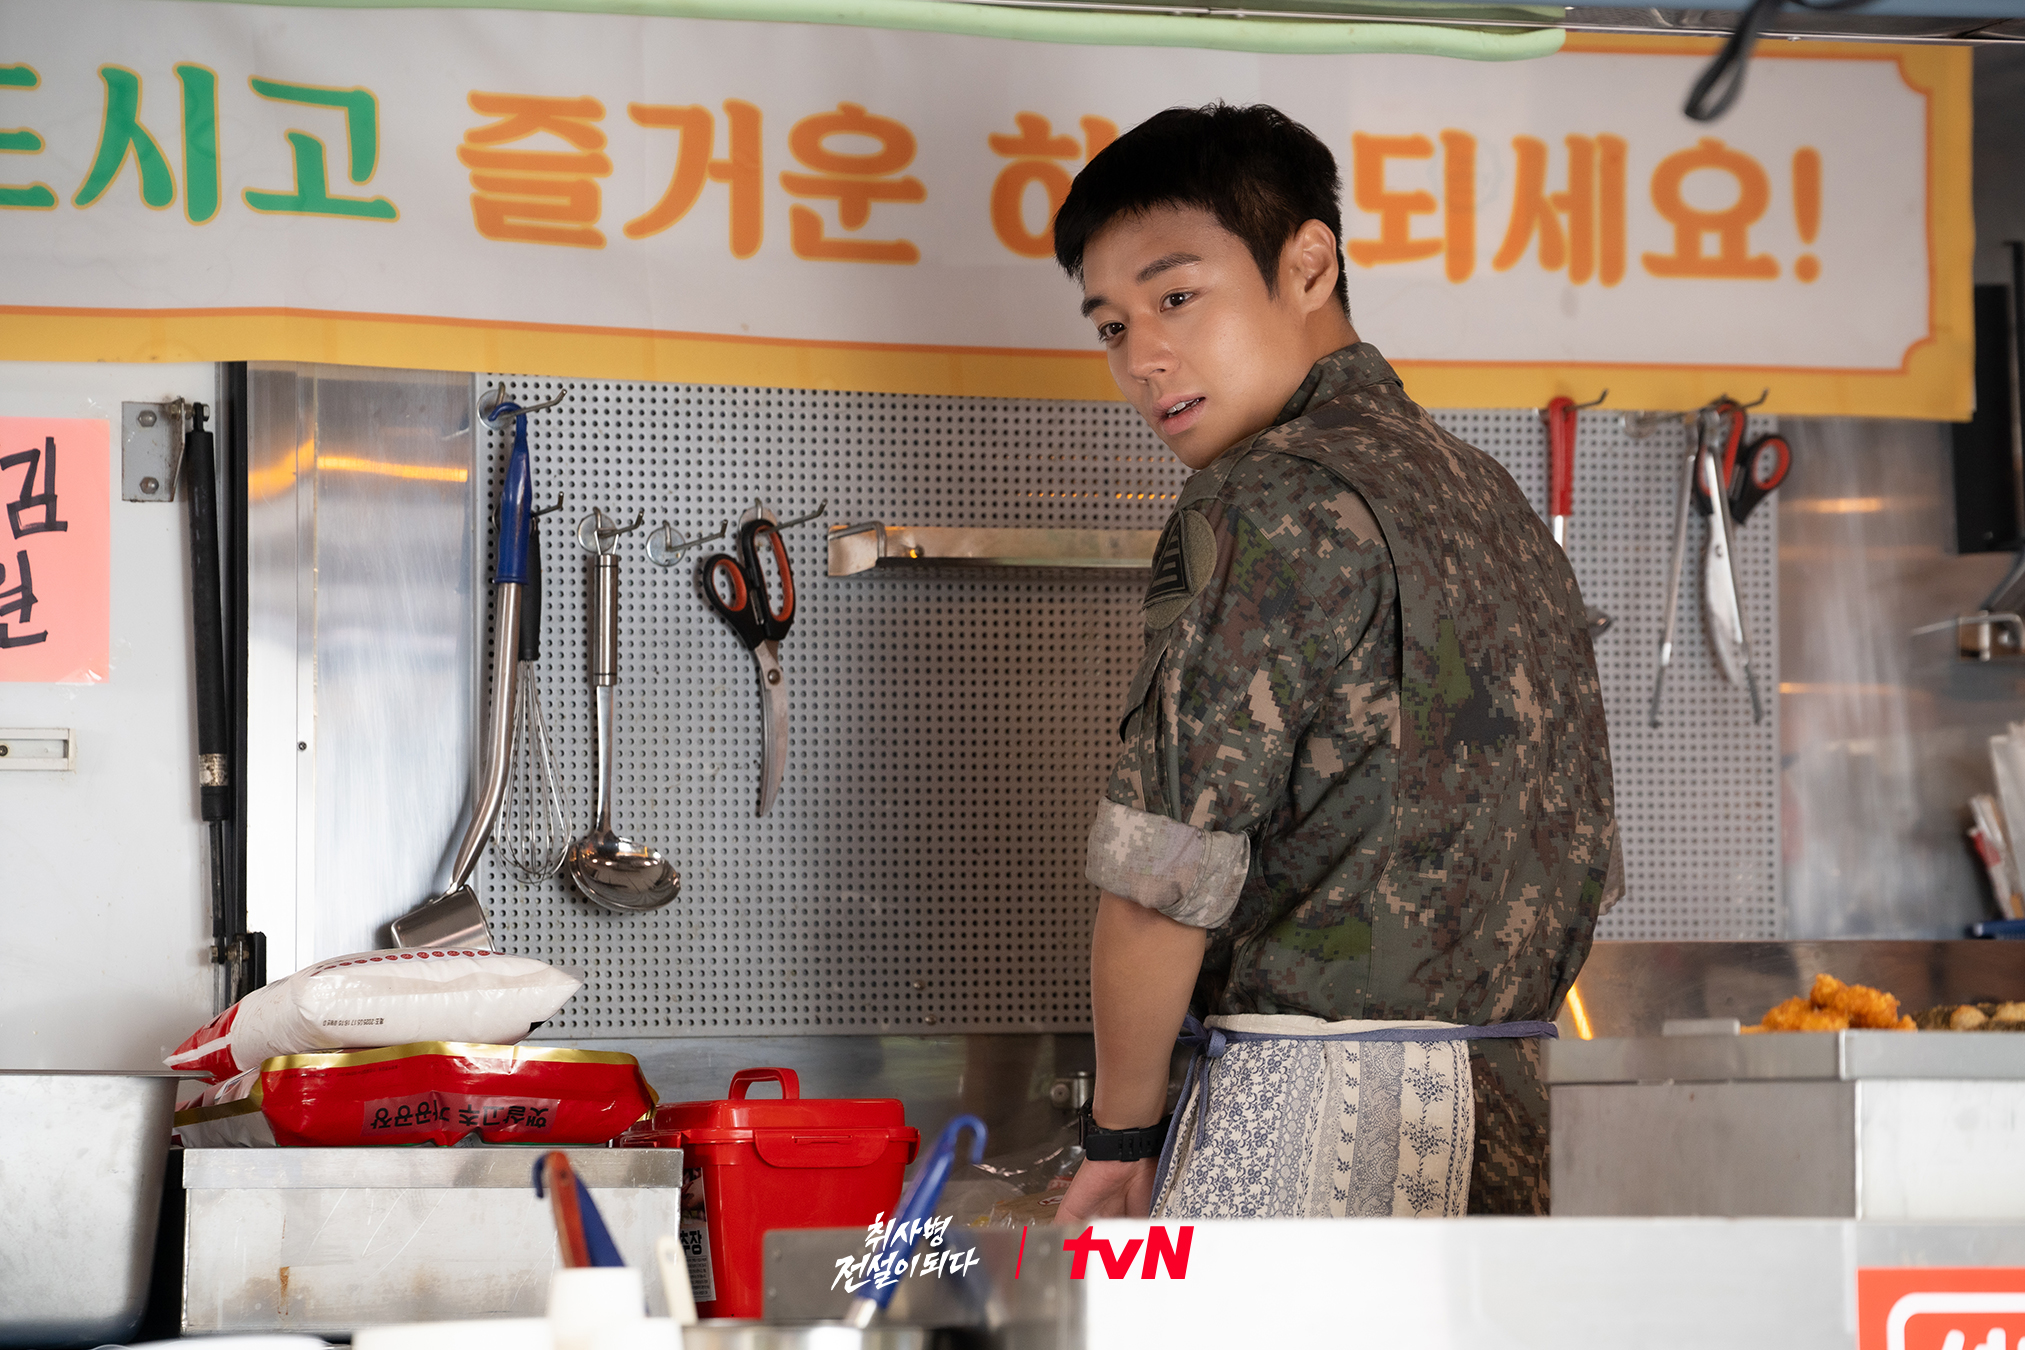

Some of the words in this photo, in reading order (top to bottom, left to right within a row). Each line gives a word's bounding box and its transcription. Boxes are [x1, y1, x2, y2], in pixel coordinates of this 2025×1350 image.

[457, 91, 927, 264] 즐거운
[988, 111, 1120, 258] 하
[1347, 129, 1822, 287] 되세요!
[370, 1099, 451, 1130] 가공공장
[458, 1103, 549, 1130] 햇살고추
[680, 1230, 703, 1256] 추장
